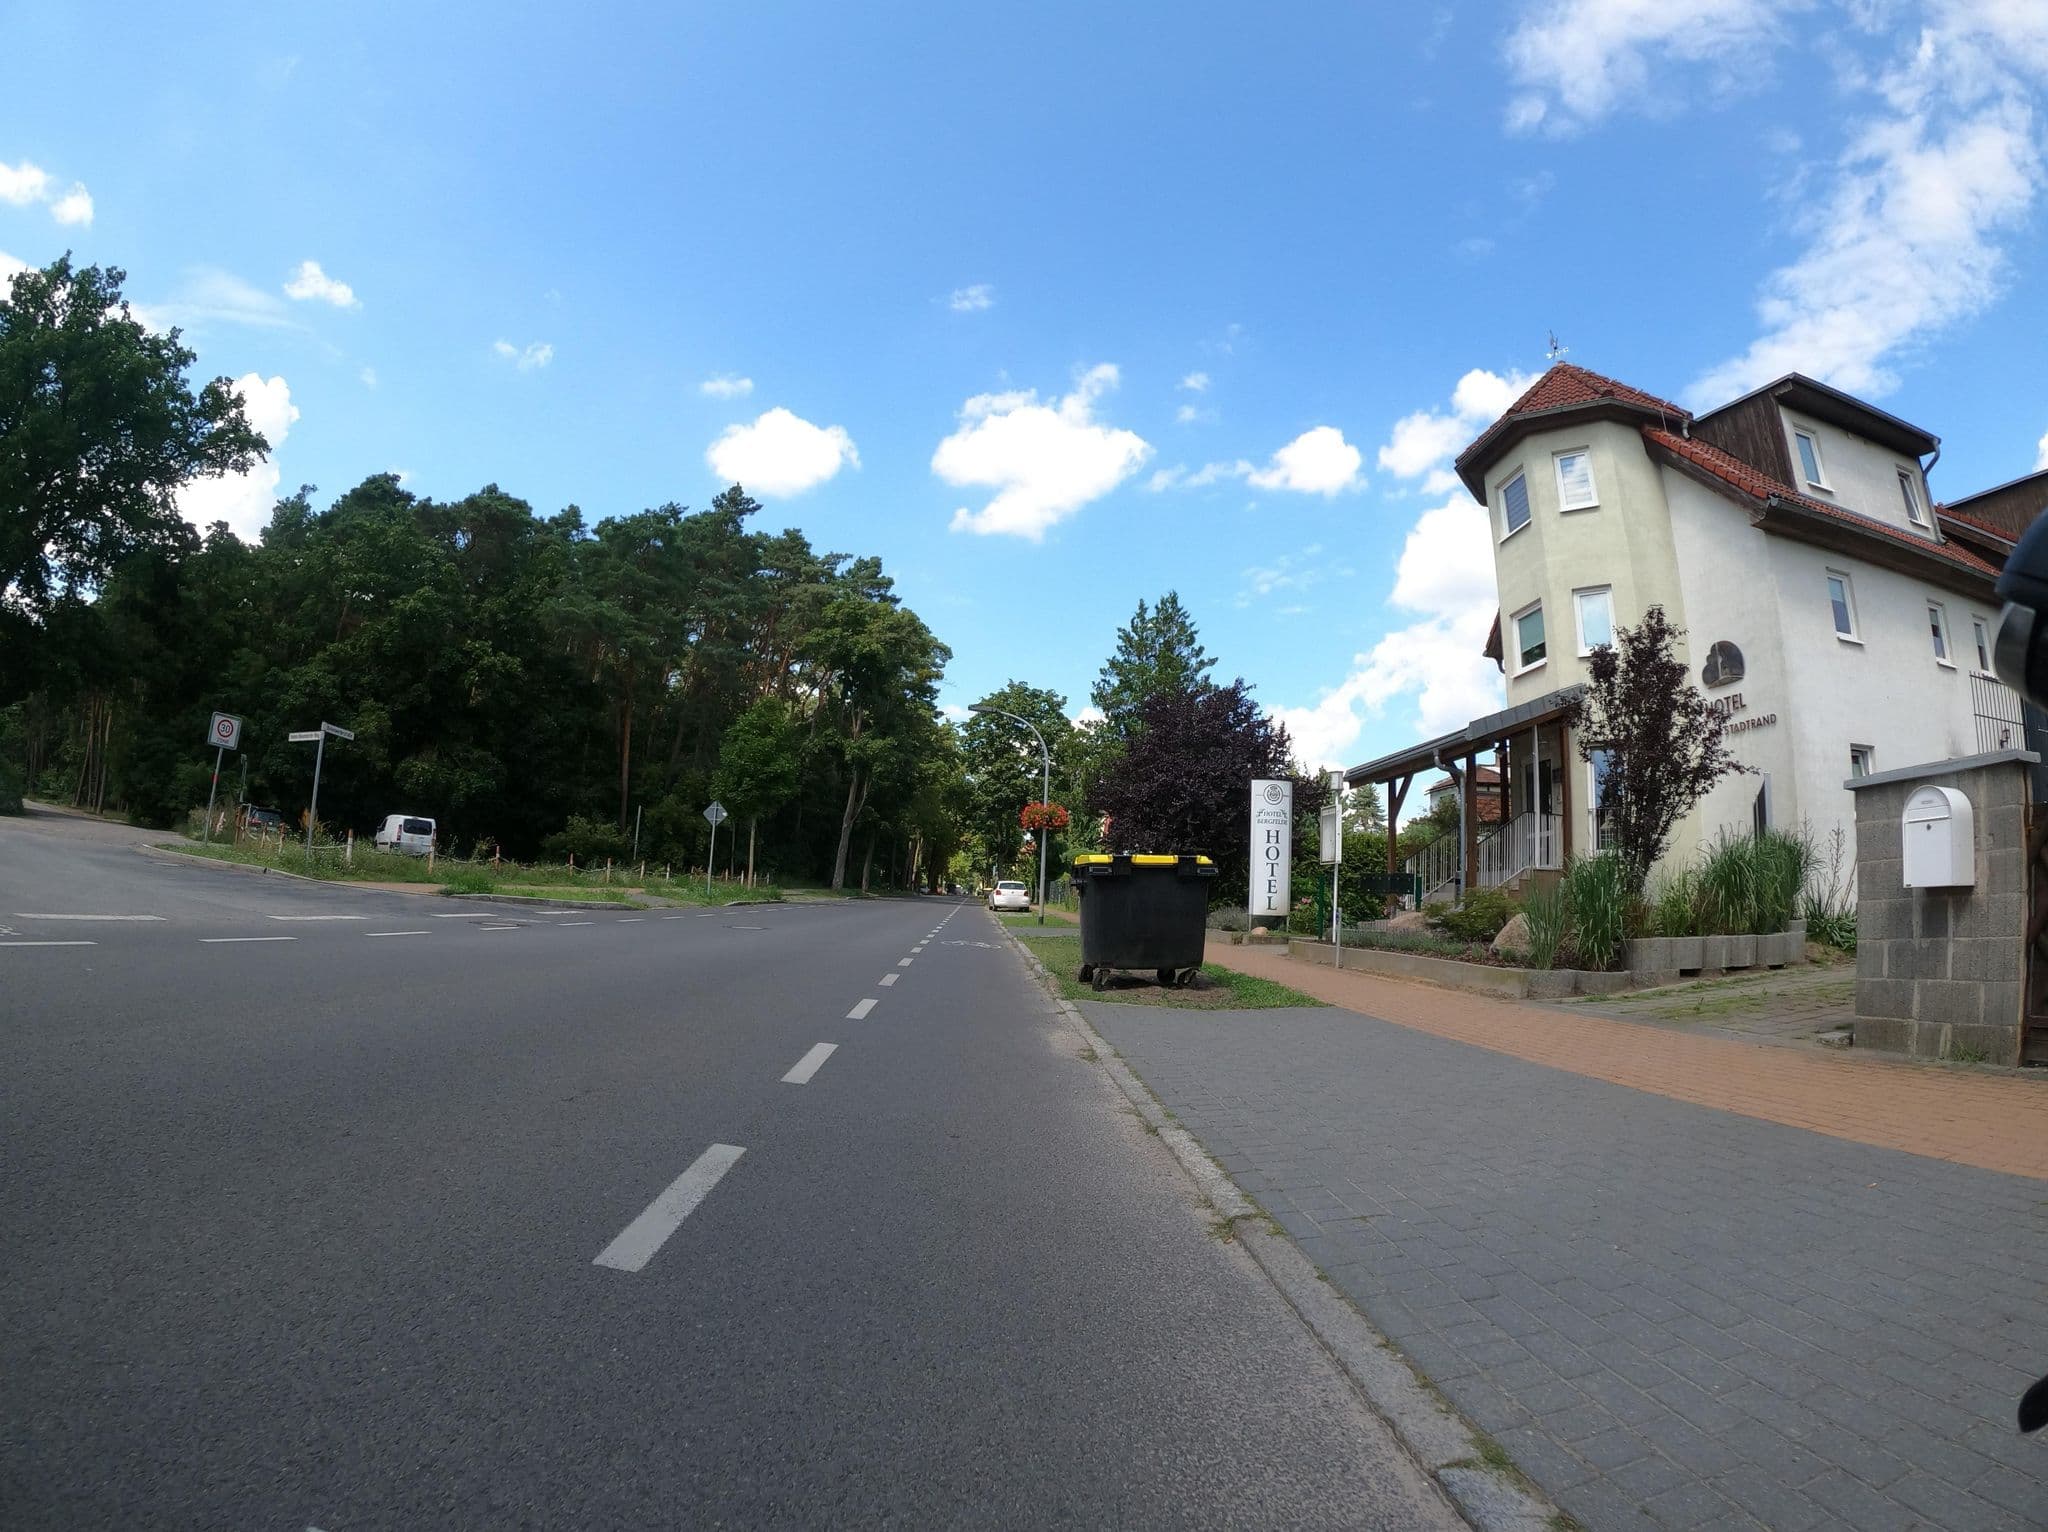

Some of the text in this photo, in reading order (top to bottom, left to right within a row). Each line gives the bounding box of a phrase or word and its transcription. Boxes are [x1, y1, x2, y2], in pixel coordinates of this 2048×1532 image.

[220, 723, 231, 733] 30
[1723, 713, 1777, 737] STADTRAND
[1265, 829, 1280, 911] HOTEL
